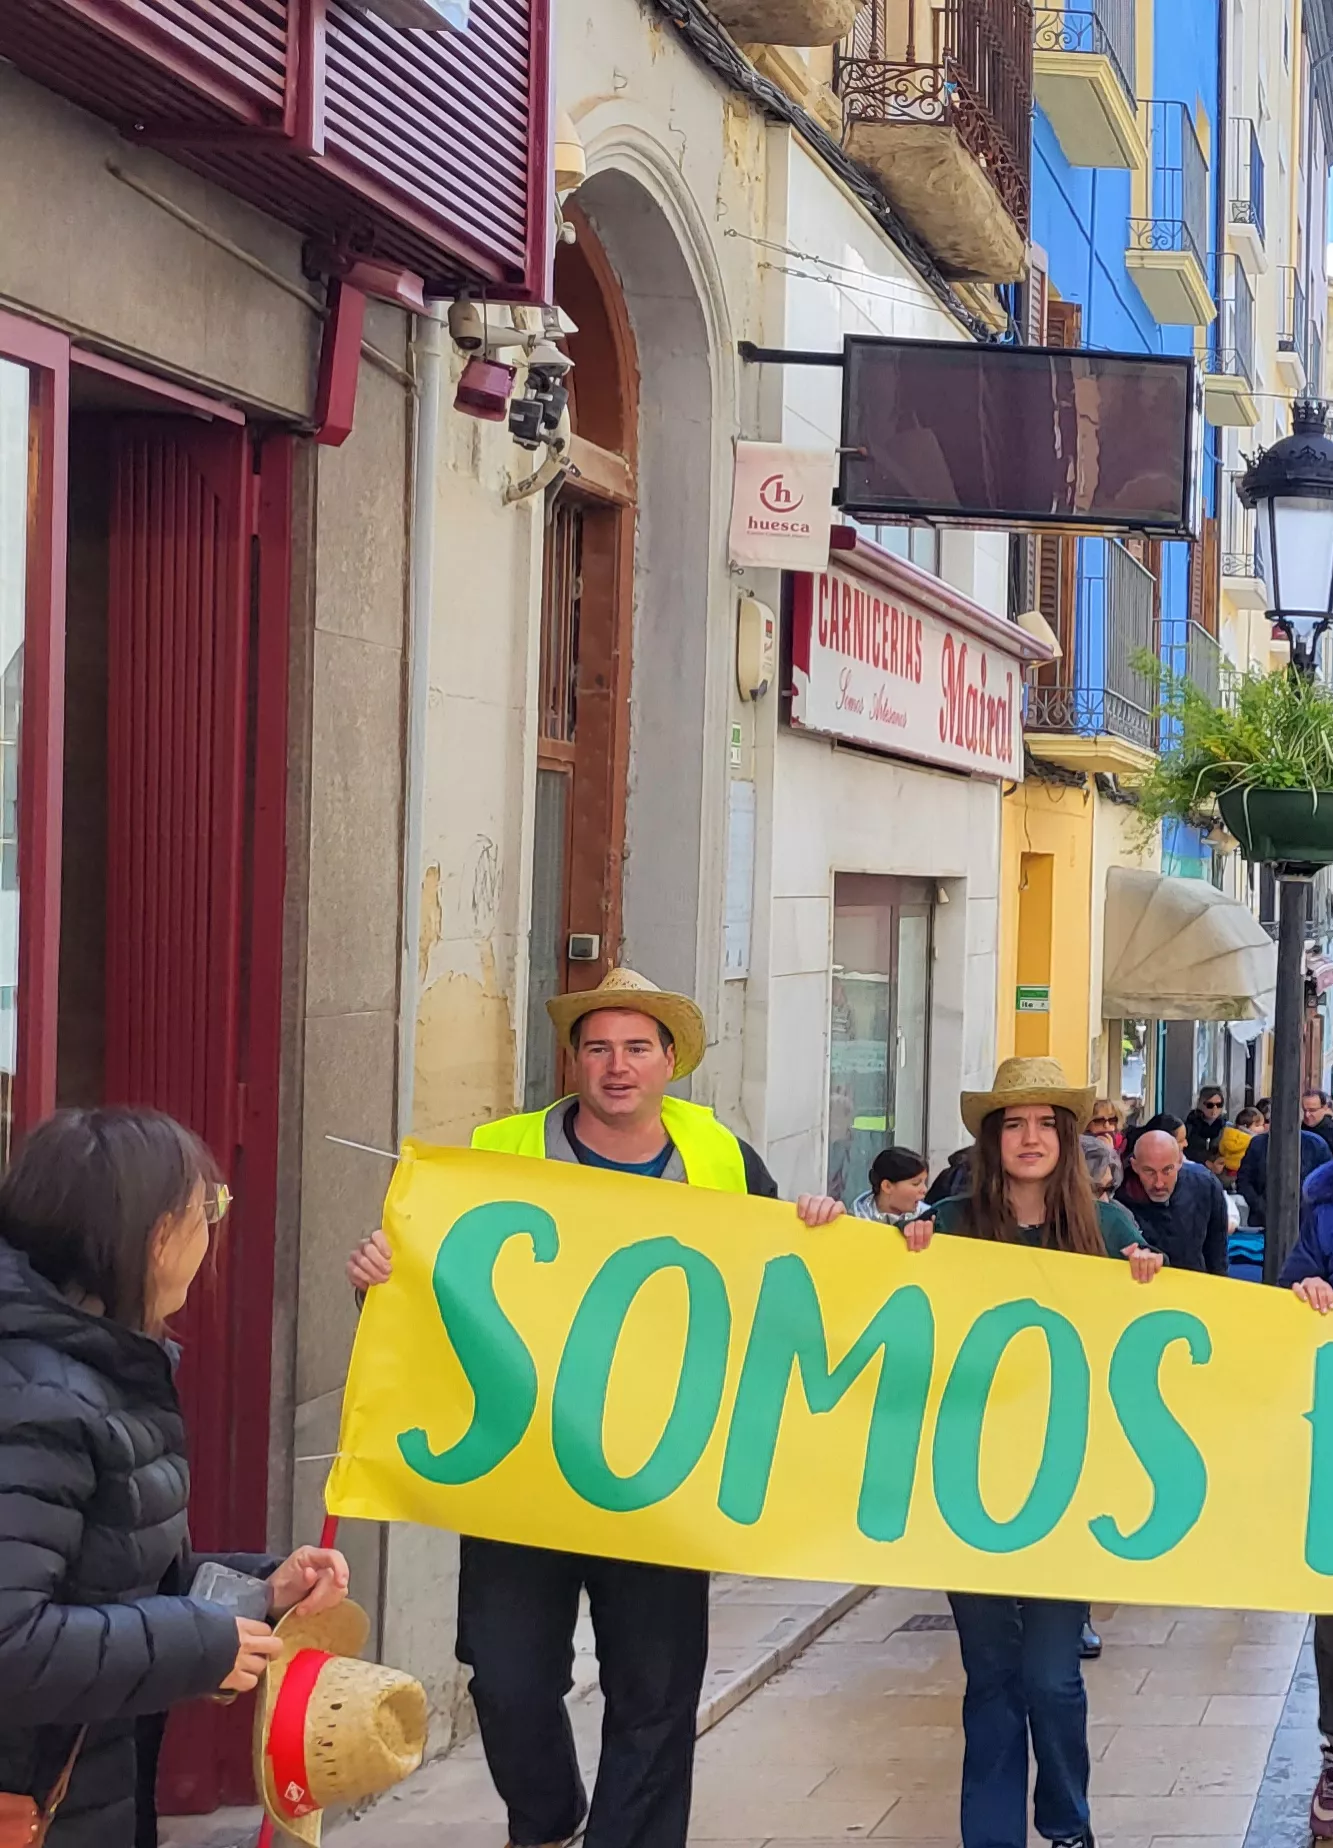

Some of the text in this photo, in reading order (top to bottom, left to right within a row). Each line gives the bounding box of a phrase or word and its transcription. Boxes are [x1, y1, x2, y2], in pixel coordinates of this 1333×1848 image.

[748, 516, 810, 533] huesca
[818, 573, 922, 684] CARNICERIAS
[939, 633, 1013, 764] Mairal
[395, 1200, 1213, 1561] SOMOS
